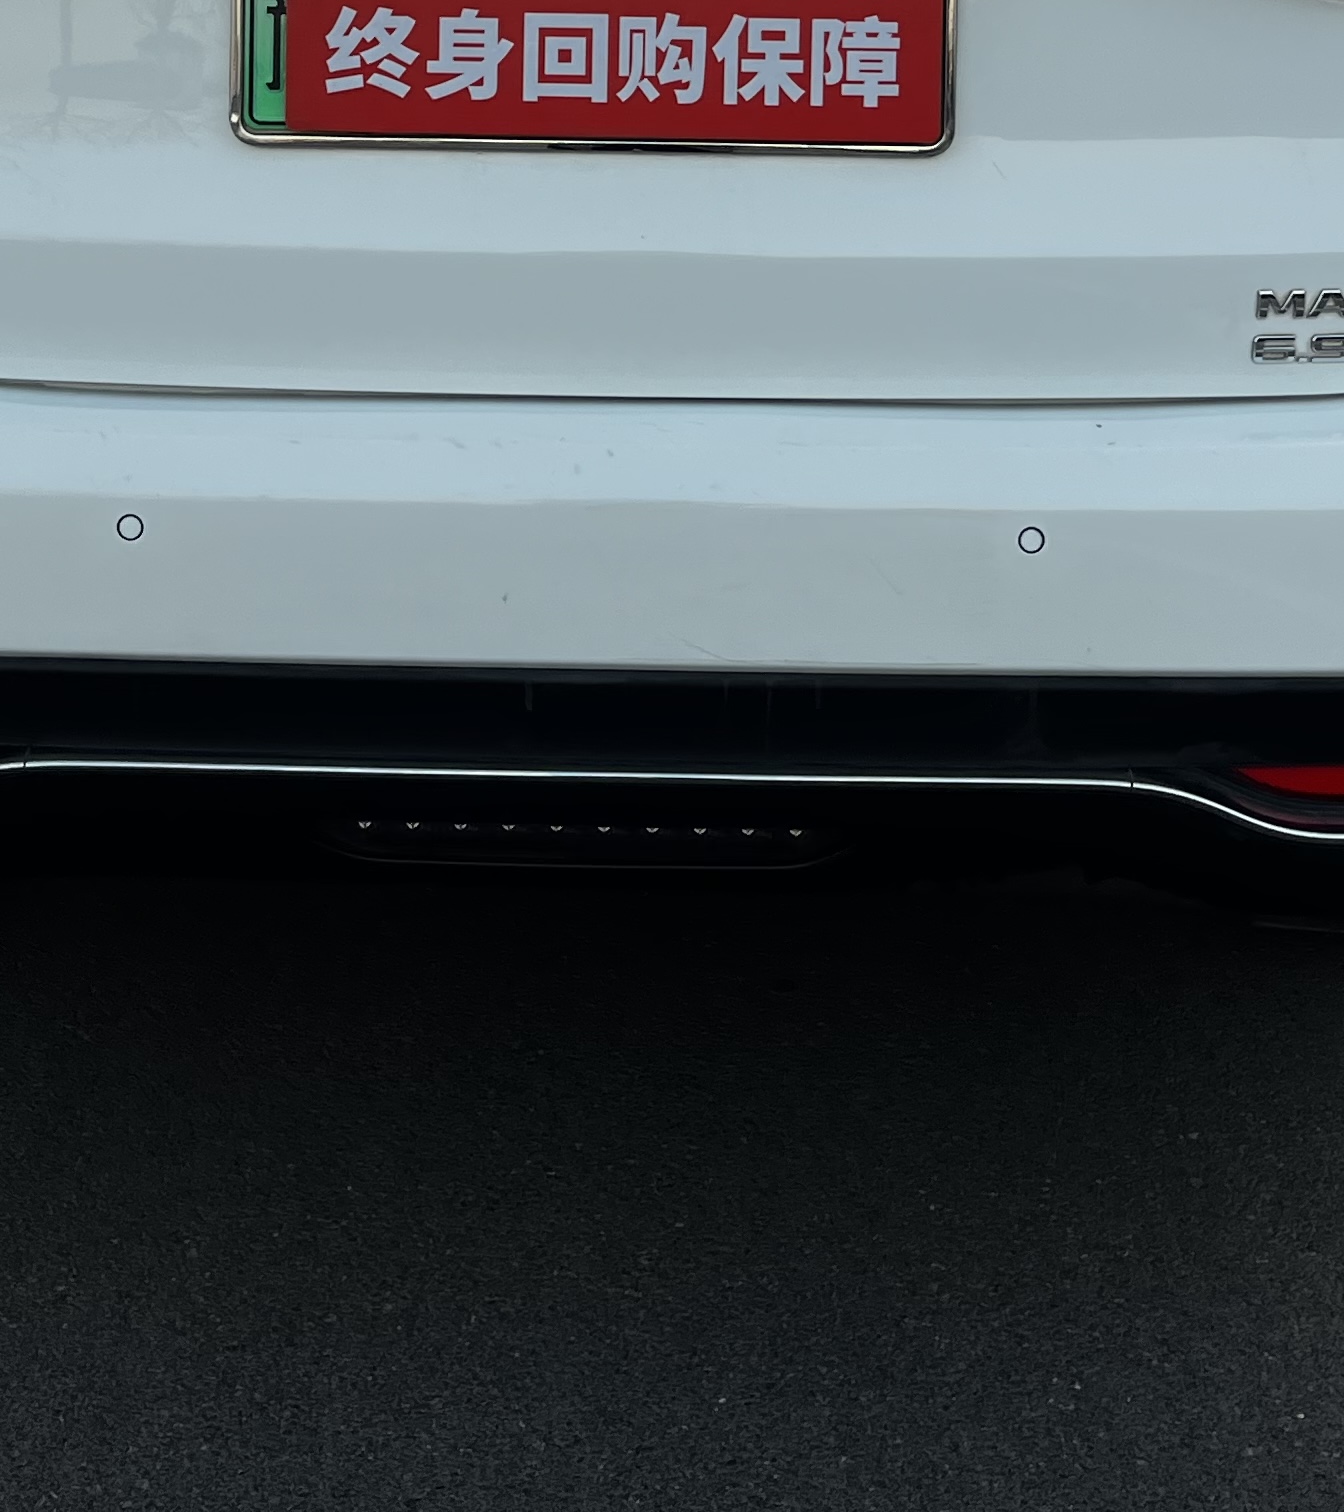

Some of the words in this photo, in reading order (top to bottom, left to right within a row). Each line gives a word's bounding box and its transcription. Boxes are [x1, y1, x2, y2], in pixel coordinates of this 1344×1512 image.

[324, 6, 902, 108] 终身回购保障
